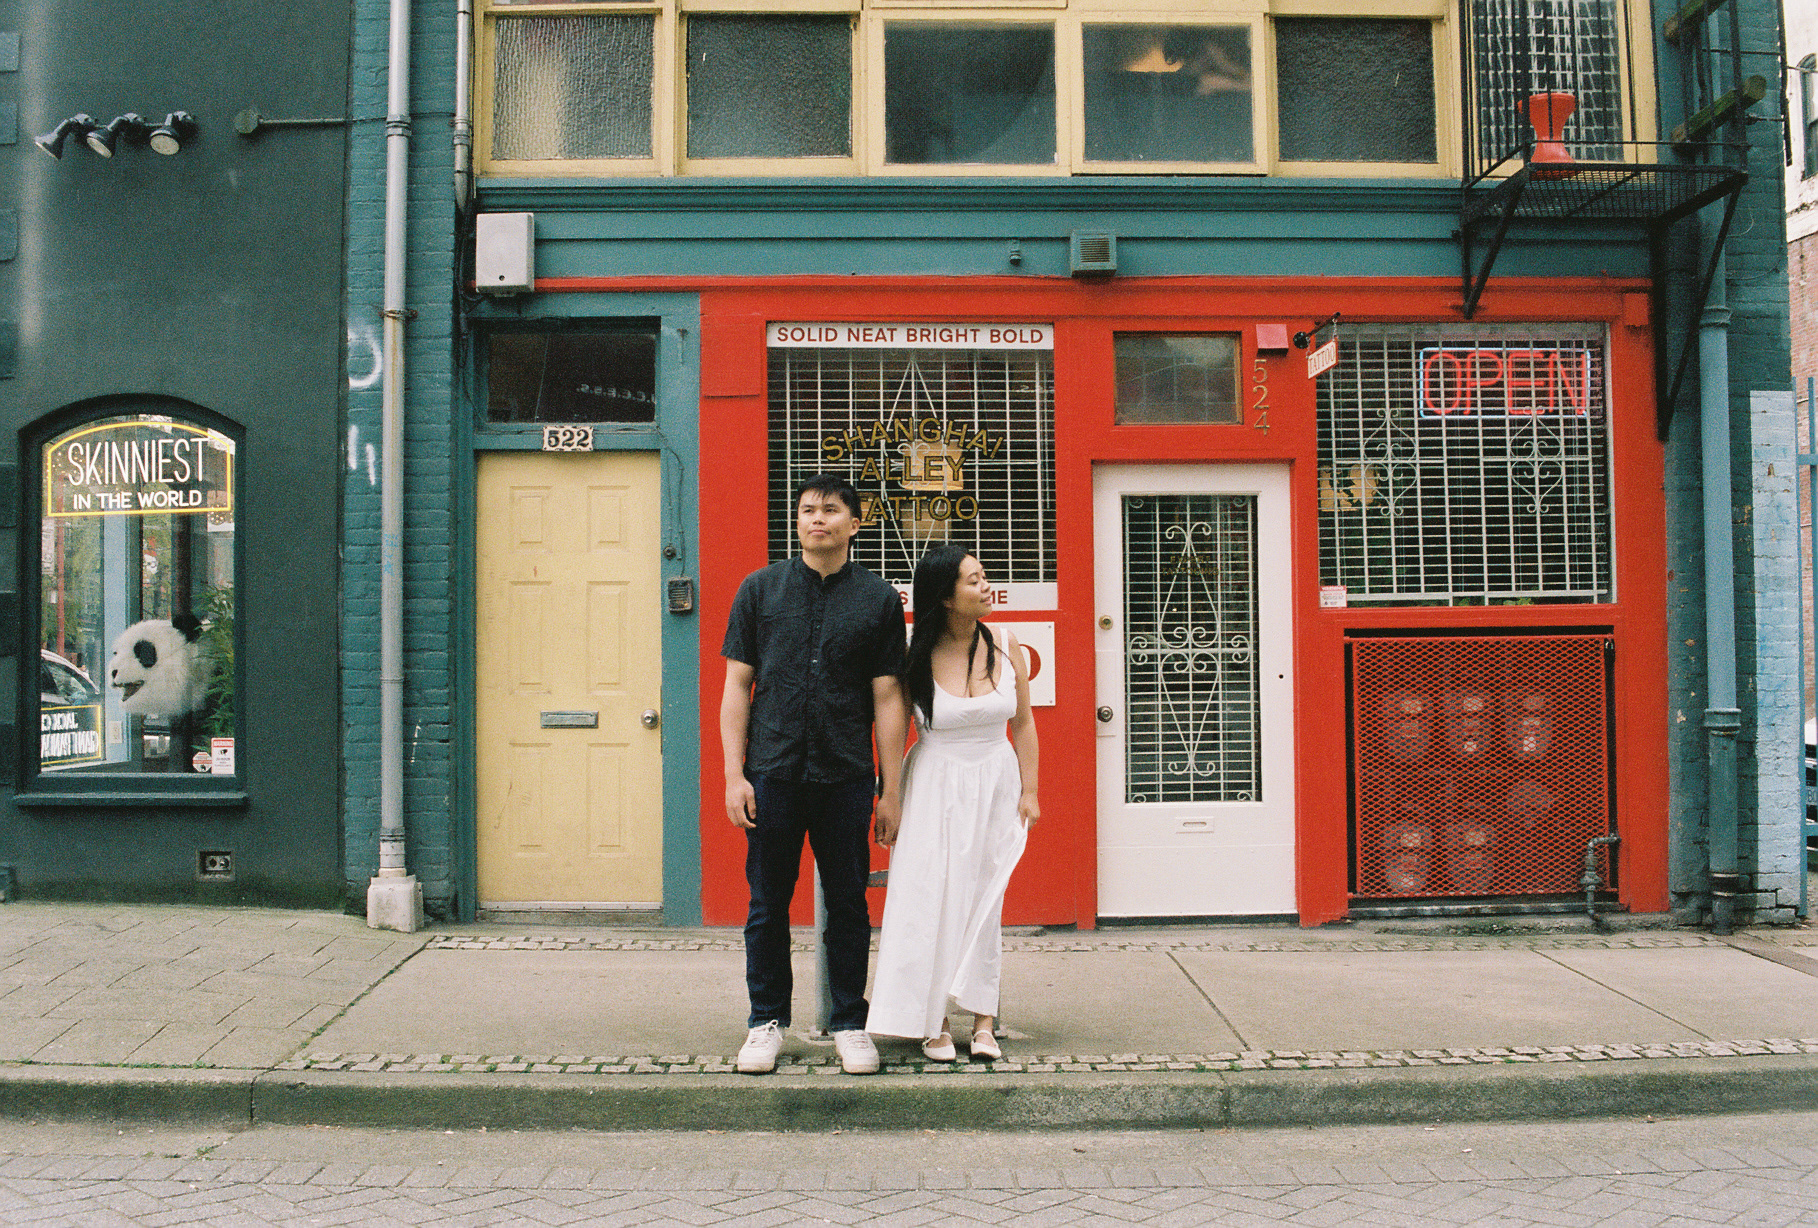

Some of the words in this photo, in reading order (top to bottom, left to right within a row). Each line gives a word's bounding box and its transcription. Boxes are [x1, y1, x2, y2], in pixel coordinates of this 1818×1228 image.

[777, 327, 838, 342] SOLID
[847, 327, 898, 342] NEAT
[906, 328, 981, 343] BRIGHT
[989, 329, 1044, 344] BOLD
[1309, 344, 1335, 375] TATTOO
[1253, 359, 1270, 436] 524
[1425, 352, 1587, 415] OPEN
[548, 429, 590, 448] 522
[821, 416, 1004, 461] SHANGHAI
[68, 438, 209, 486] SKINNIEST
[860, 456, 966, 481] ALLEY
[73, 493, 91, 509] IN
[96, 492, 133, 508] THE
[137, 490, 202, 508] WORLD
